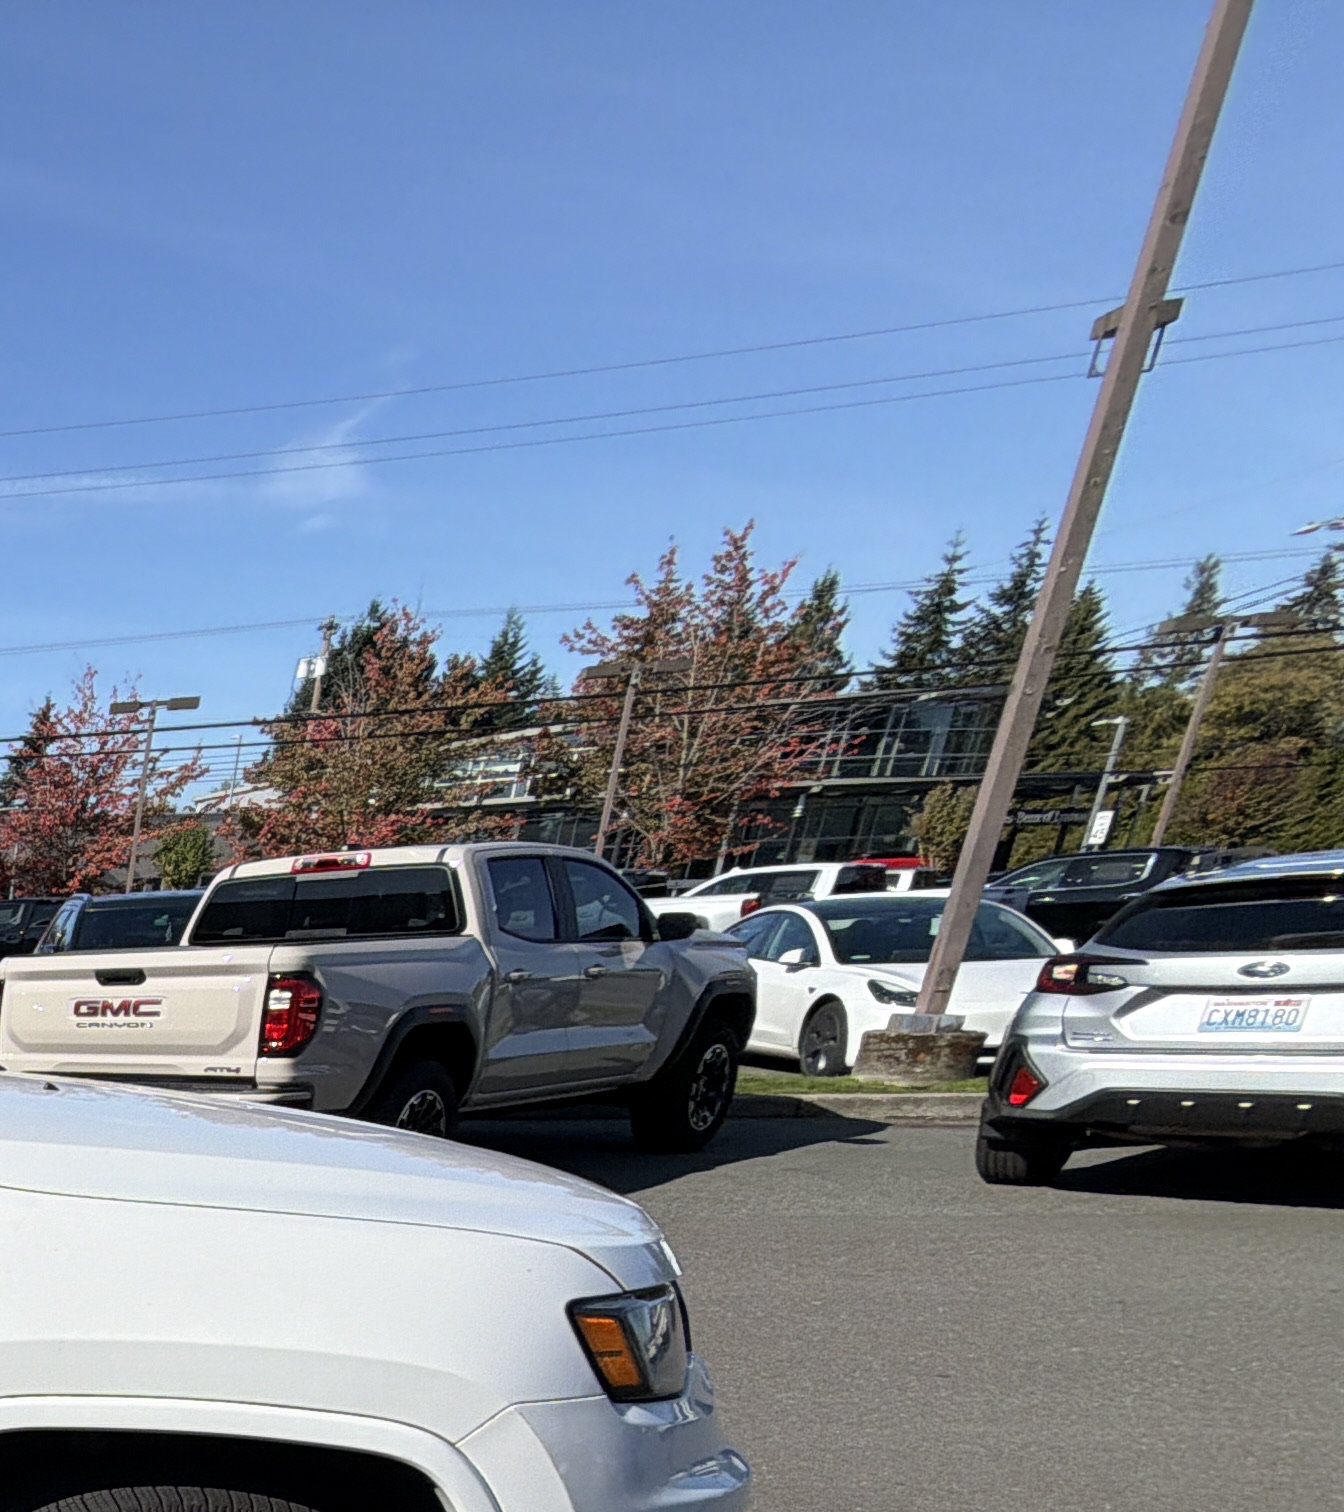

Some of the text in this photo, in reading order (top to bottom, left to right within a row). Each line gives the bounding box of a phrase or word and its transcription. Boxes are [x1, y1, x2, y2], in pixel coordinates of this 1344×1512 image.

[73, 999, 163, 1018] GMC
[1205, 1008, 1301, 1027] CXM8180
[75, 1021, 154, 1029] CANYON
[204, 1066, 242, 1074] AT4
